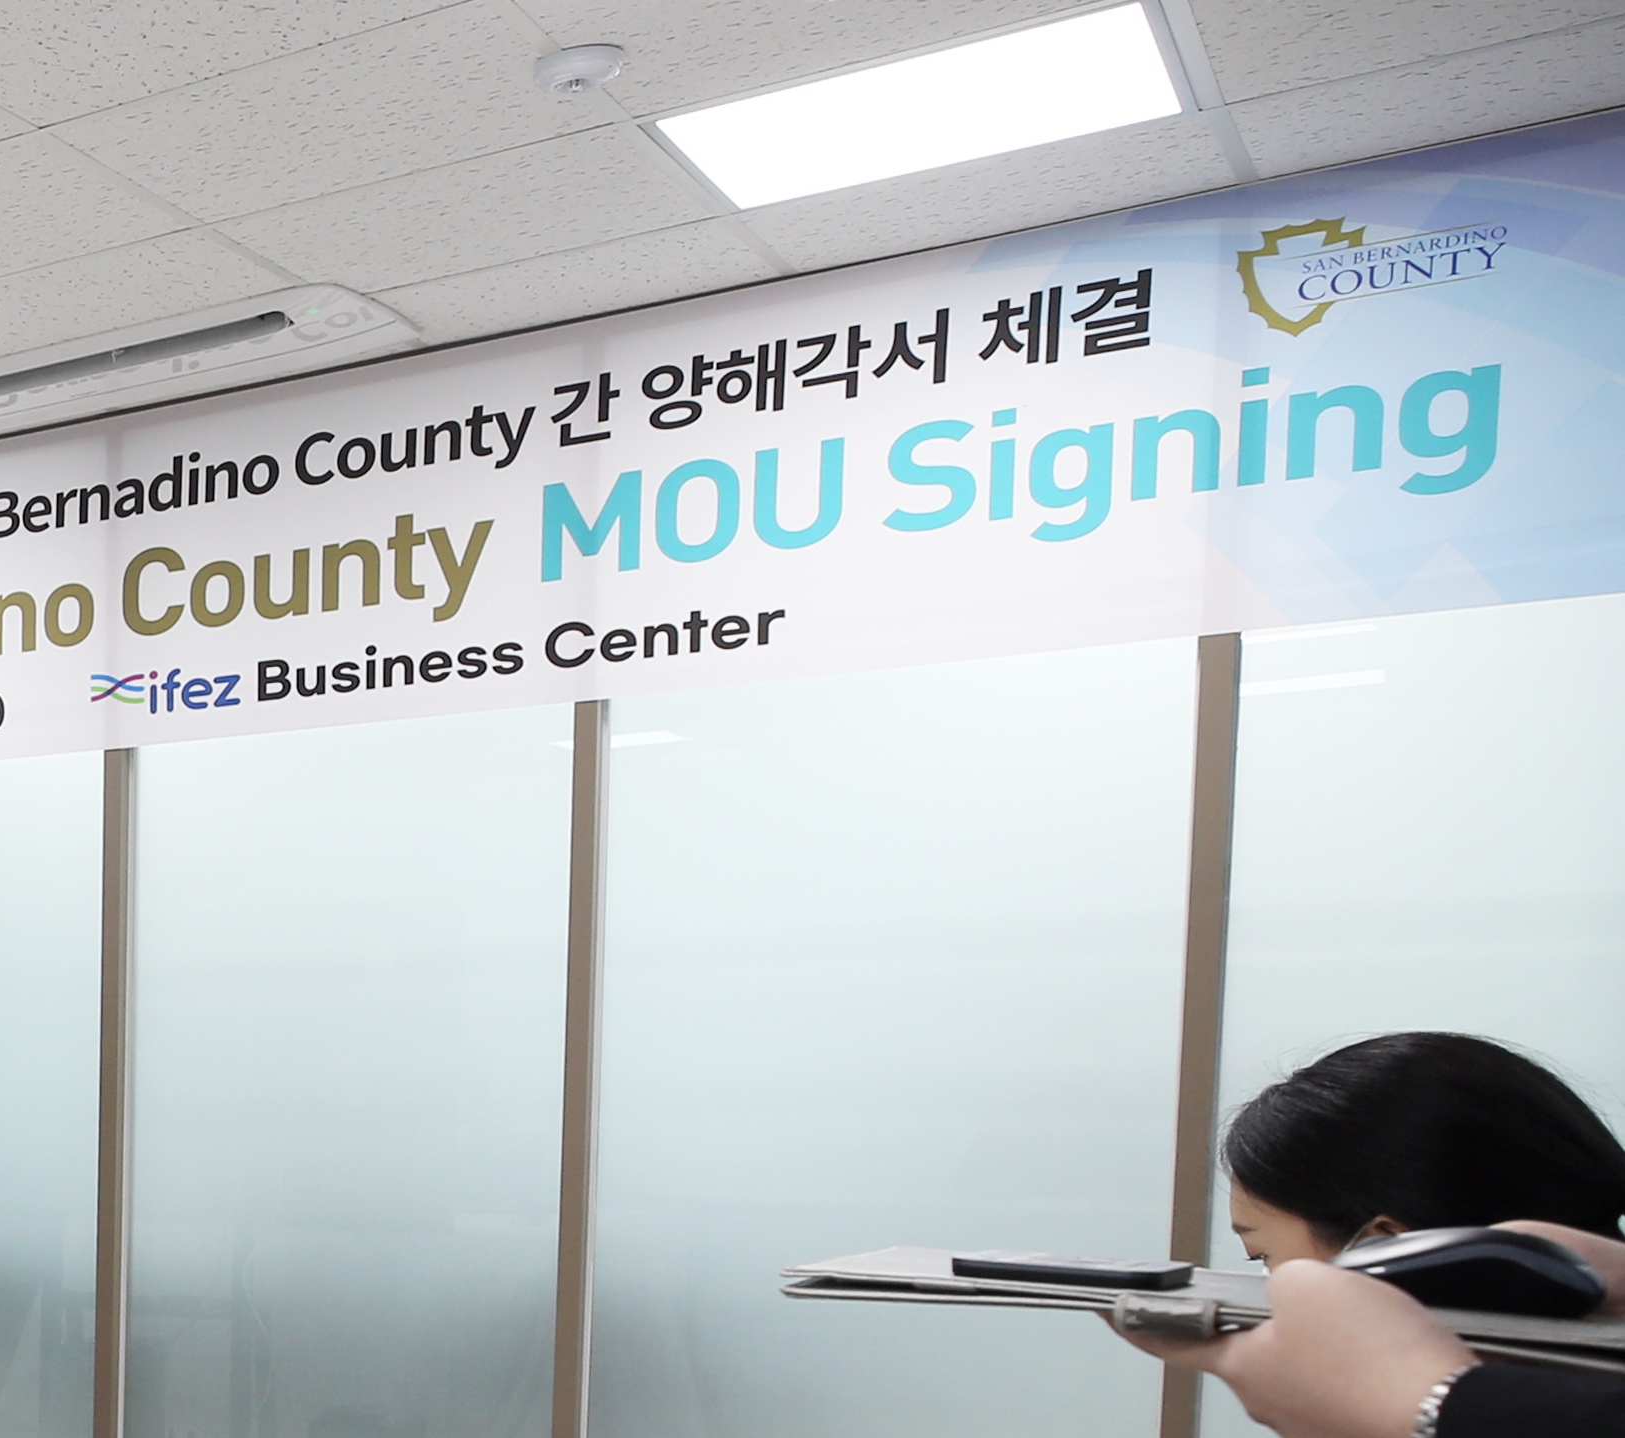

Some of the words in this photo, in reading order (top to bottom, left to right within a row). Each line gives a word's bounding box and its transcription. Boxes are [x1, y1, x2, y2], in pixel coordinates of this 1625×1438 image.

[1298, 242, 1507, 301] COUNTY
[1301, 254, 1345, 275] SAN
[1352, 226, 1508, 266] BERNARDINO
[295, 404, 537, 485] County
[551, 371, 620, 447] 간
[641, 309, 949, 430] 양해각서
[977, 268, 1153, 366] 체결
[122, 512, 495, 637] County
[540, 437, 845, 582] MOU
[882, 363, 1503, 543] Signing
[149, 668, 241, 714] ifez
[257, 643, 524, 702] Business
[544, 608, 786, 668] Center
